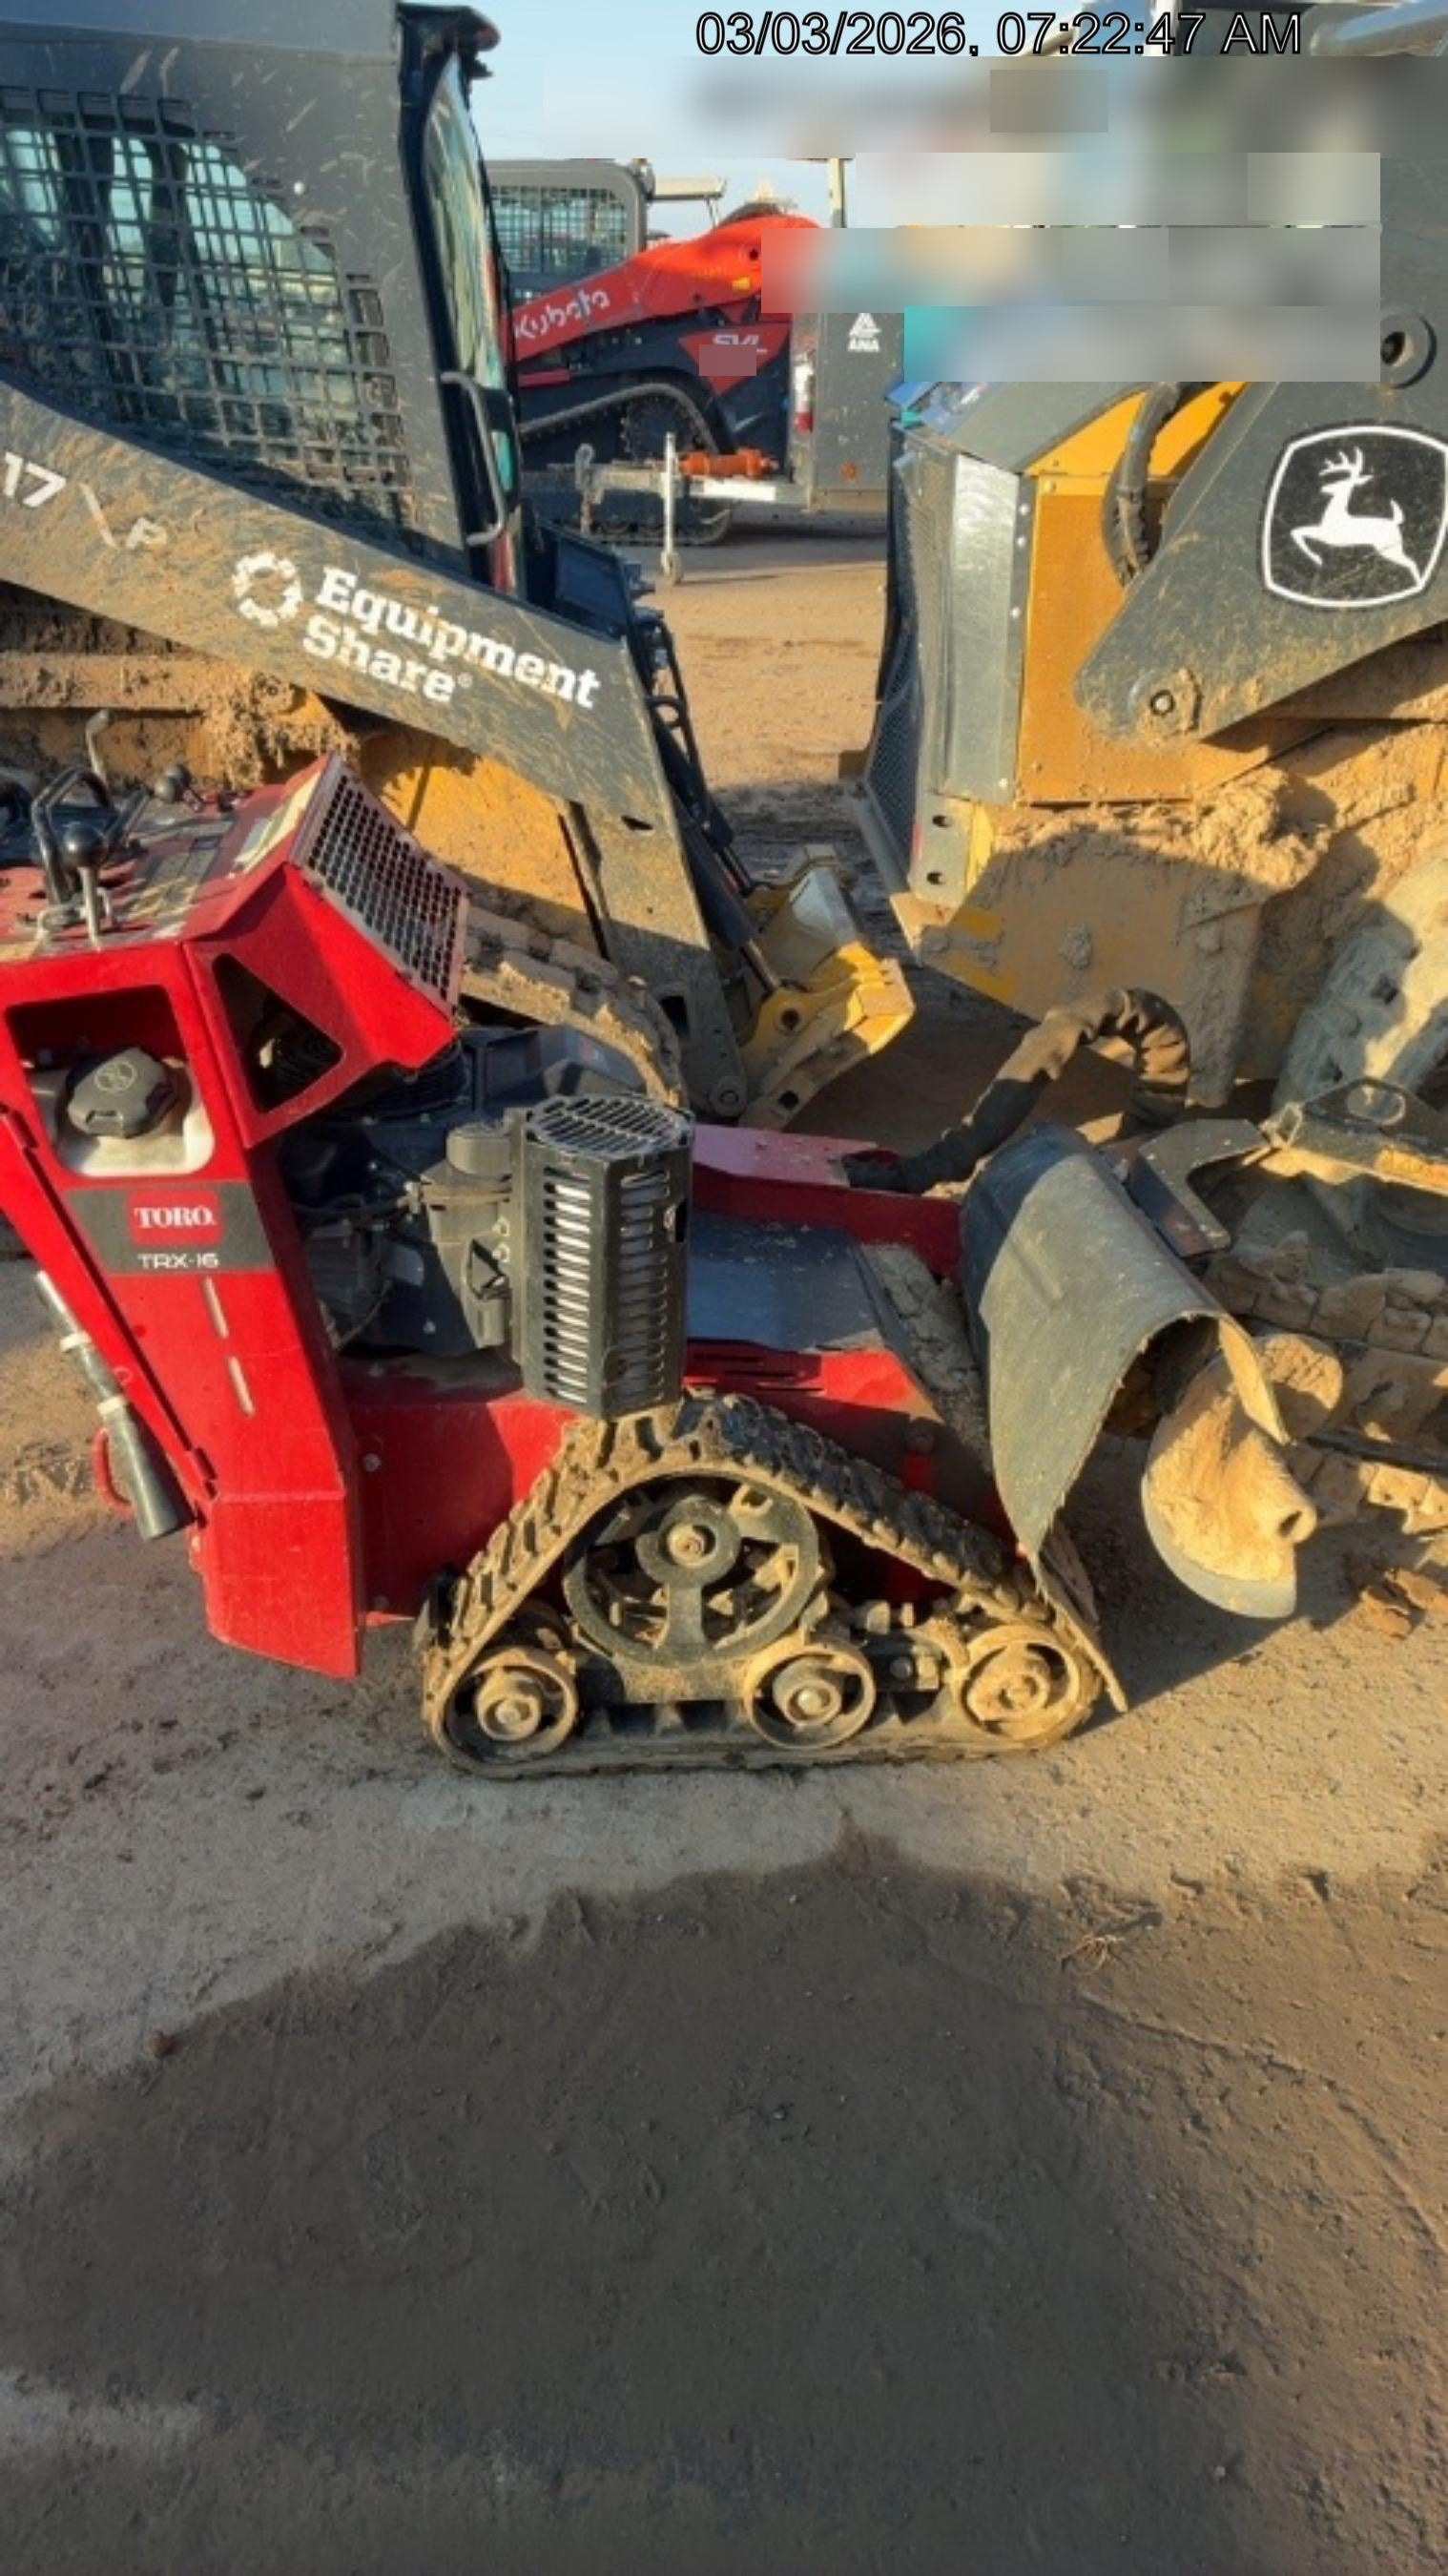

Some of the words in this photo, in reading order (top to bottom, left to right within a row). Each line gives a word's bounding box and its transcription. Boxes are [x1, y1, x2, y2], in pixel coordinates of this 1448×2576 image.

[514, 288, 610, 339] Kubota
[314, 565, 602, 709] Equipment
[136, 1252, 220, 1269] TRX-16
